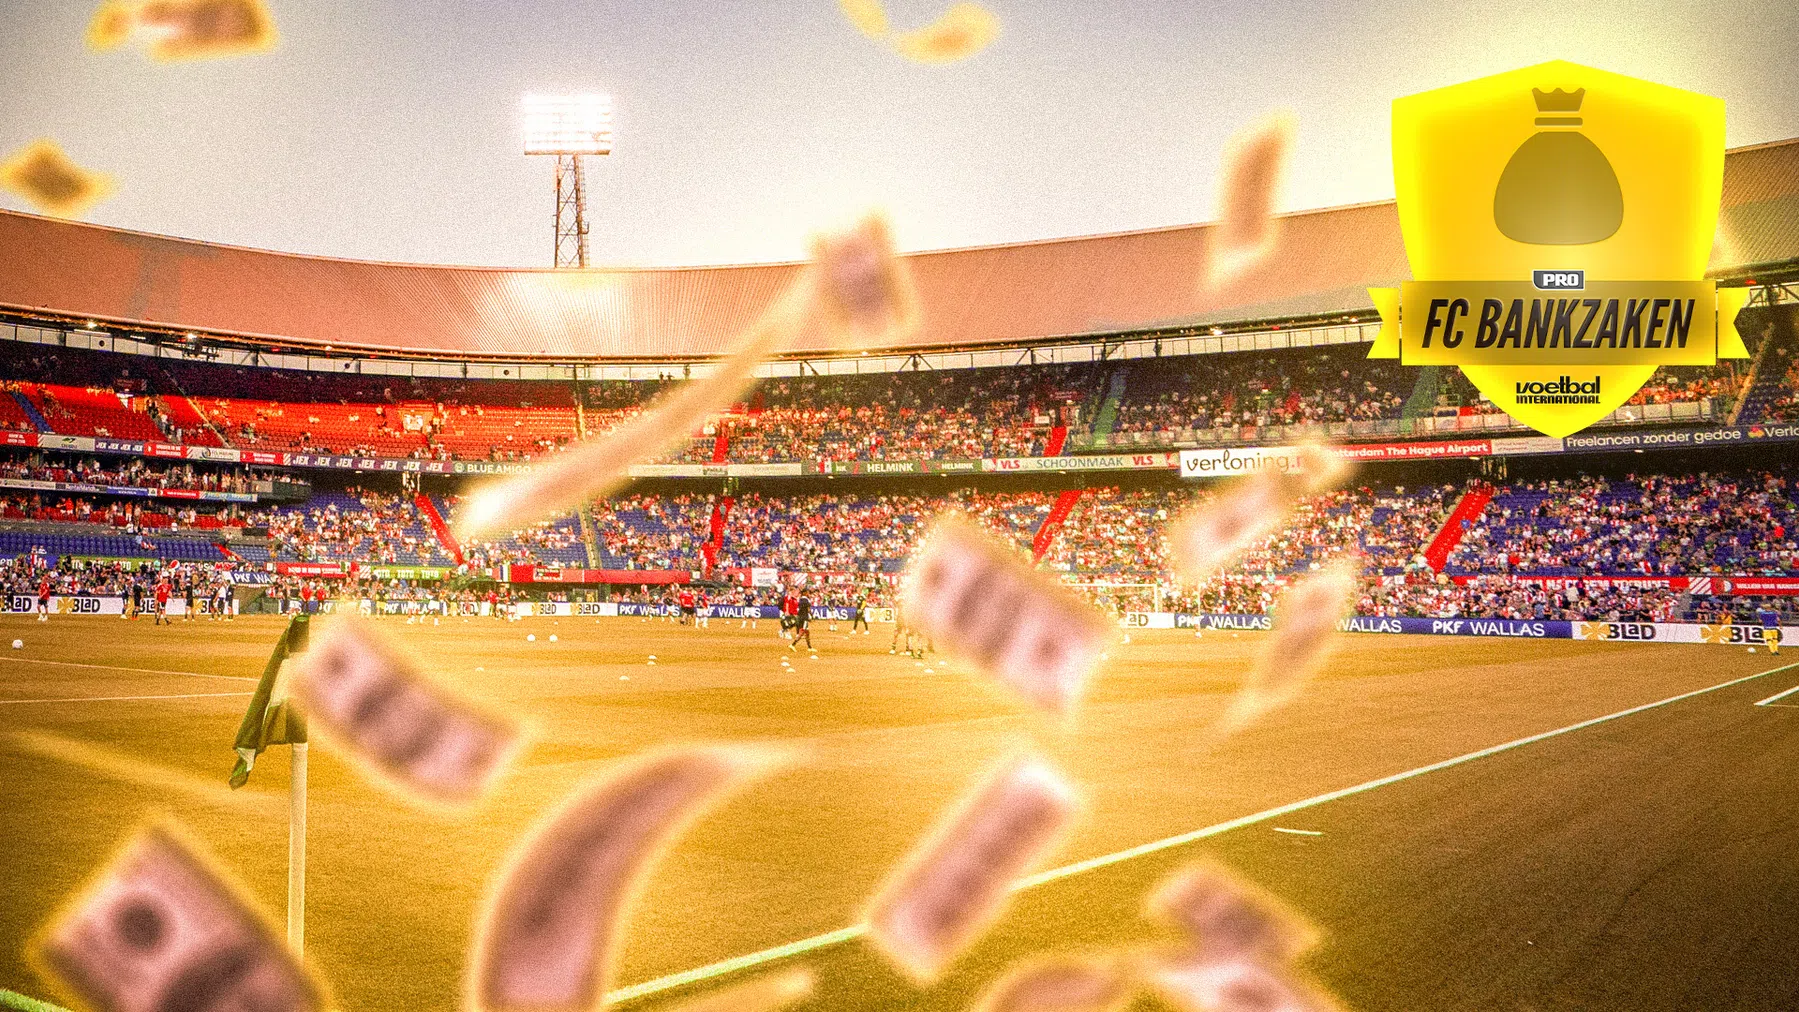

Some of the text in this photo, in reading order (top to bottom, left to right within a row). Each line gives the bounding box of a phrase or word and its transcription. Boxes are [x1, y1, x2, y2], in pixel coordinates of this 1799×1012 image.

[1566, 434, 1640, 448] Freelancen
[1643, 431, 1691, 444] zonder
[1694, 428, 1742, 444] gedoe
[120, 443, 131, 451] JEX
[1386, 447, 1407, 456] The
[1409, 444, 1445, 457] Hague
[1447, 442, 1489, 454] Airport
[293, 455, 444, 472] JEX JEX JEX JEX JEX JEX JEX
[941, 462, 974, 470] HELMINK
[1000, 459, 1021, 470] VLS
[1036, 456, 1124, 469] SCHOONMAAK
[1132, 455, 1154, 466] VLS
[467, 463, 531, 474] BLUE AMIGO
[867, 463, 914, 473] HELMINK
[620, 604, 637, 615] PKF
[1209, 616, 1273, 630] WALLAS
[1335, 618, 1402, 633] WALLAS
[1432, 620, 1545, 637] PKF WALLAS
